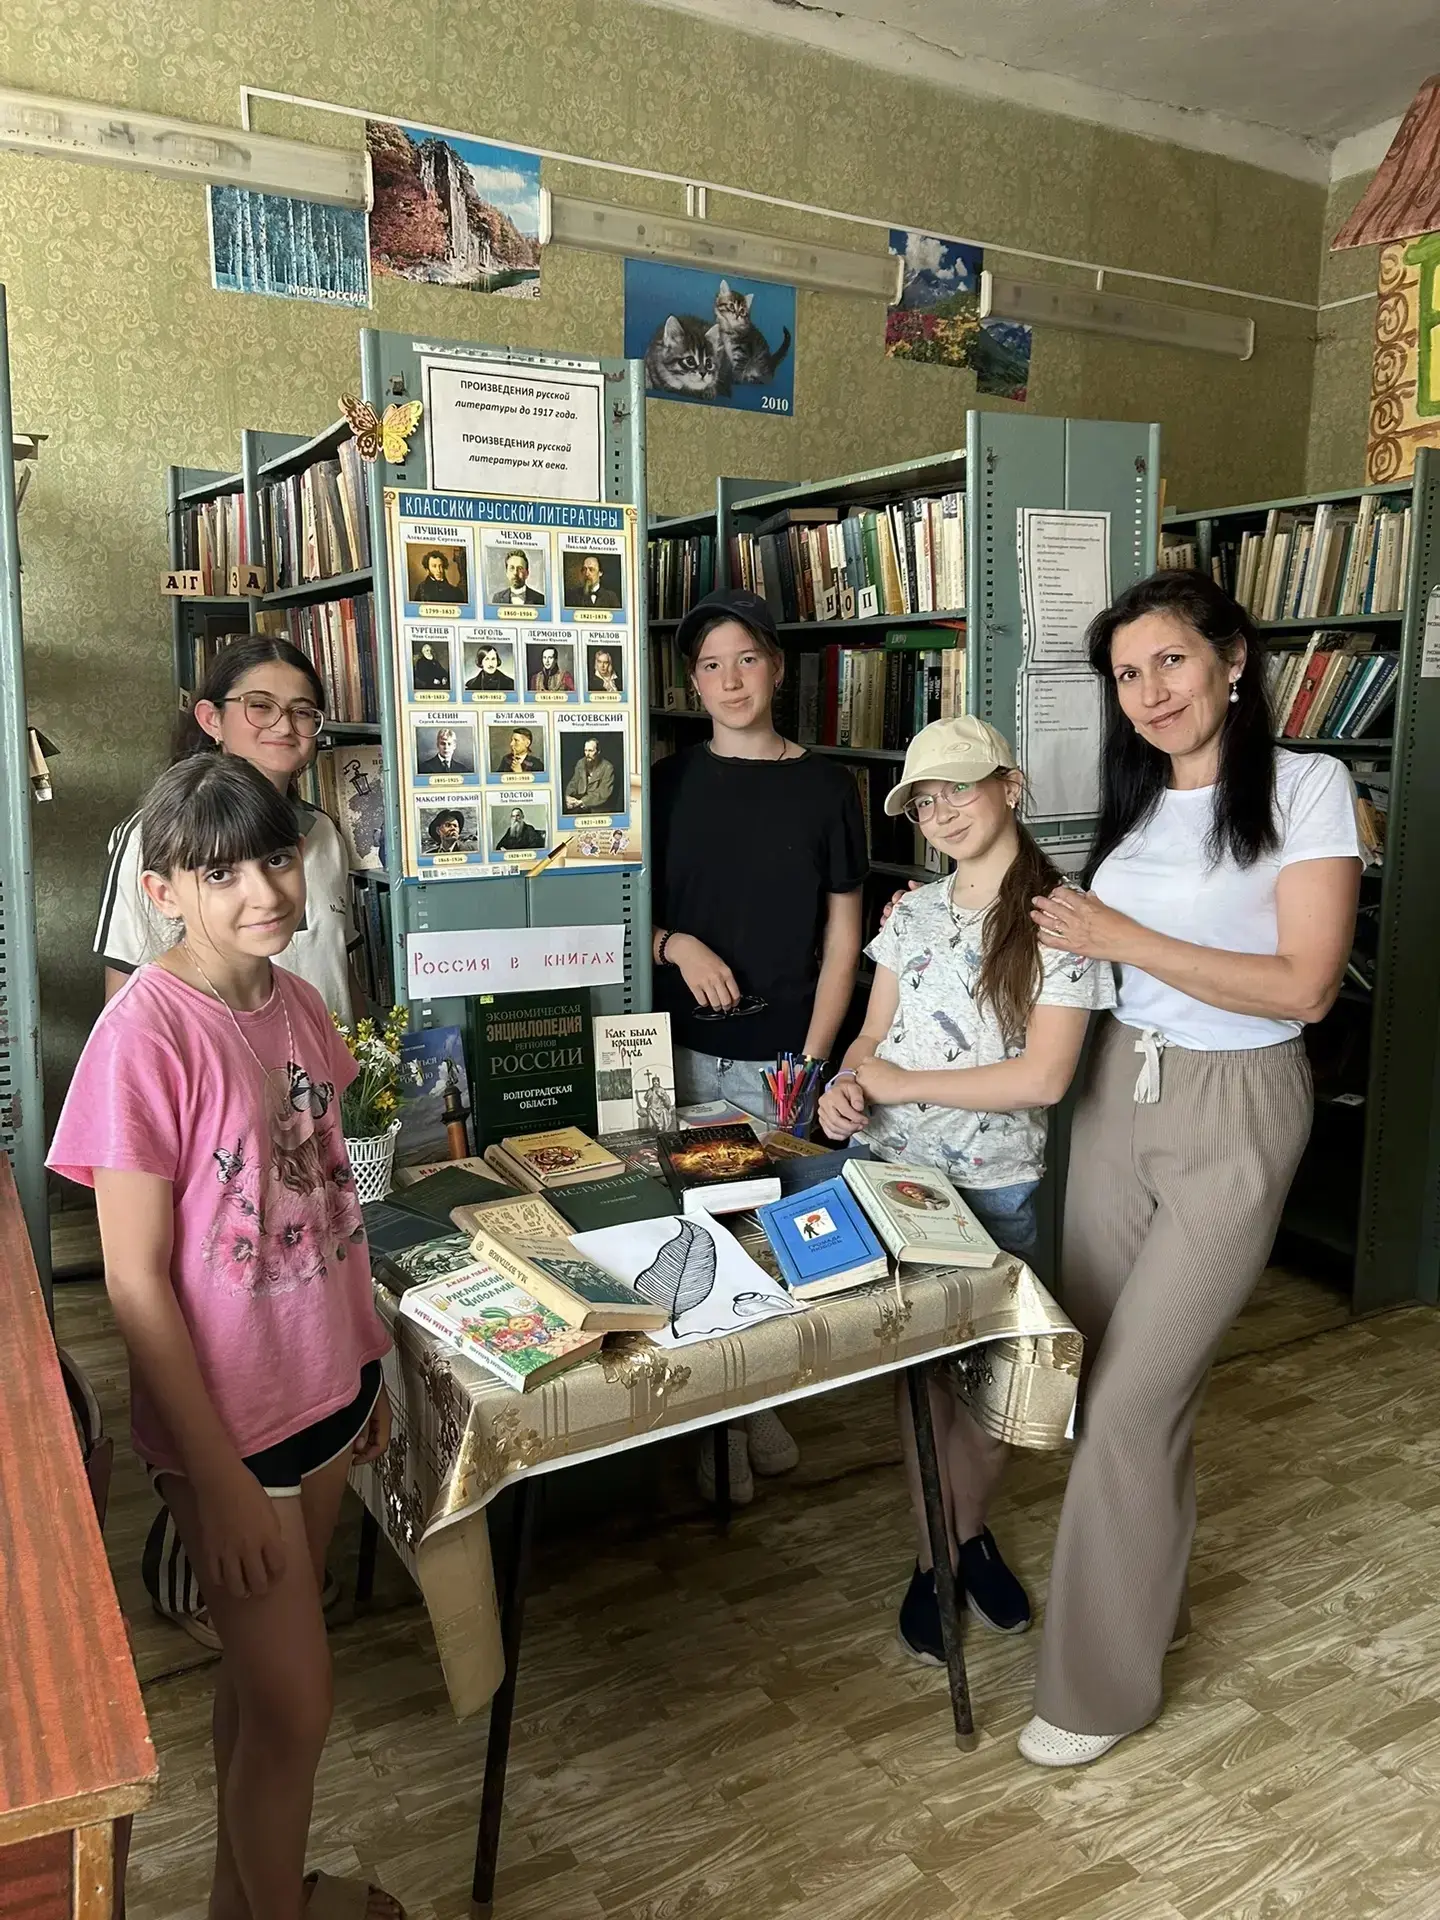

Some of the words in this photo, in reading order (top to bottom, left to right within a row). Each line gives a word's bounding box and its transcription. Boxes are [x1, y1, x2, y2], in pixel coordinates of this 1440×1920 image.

[460, 380, 534, 397] ПРОИЗВЕДЕНИЯ
[536, 389, 570, 401] русской
[455, 400, 518, 415] литературы
[519, 405, 531, 415] до
[532, 406, 553, 418] 1917
[555, 410, 578, 420] года.
[761, 395, 789, 412] 2010
[462, 433, 535, 450] ПРОИЗВЕДЕНИЯ
[537, 442, 572, 453] русской
[468, 454, 530, 468] литературы
[545, 461, 568, 471] века.
[405, 497, 473, 518] КЛАССИКИ
[478, 502, 534, 523] РУССКОЙ
[538, 505, 618, 527] ЛИТЕРАТУРЫ
[414, 525, 458, 537] ПУШКИН
[500, 530, 532, 540] ЧЕХОВ
[567, 535, 616, 546] НЕКРАСОВ
[166, 575, 179, 589] А
[246, 572, 261, 589] А
[826, 596, 834, 613] Н
[845, 595, 852, 612] О
[862, 592, 872, 609] П
[528, 630, 572, 638] ЛЕРМОНТОВ
[558, 713, 623, 722] ДОСТОЕВСКИЙ
[447, 794, 479, 802] ГОРЬКИЙ
[500, 791, 533, 799] ТОЛСТОЙ
[486, 1004, 581, 1021] ЭКОНОМИЧЕСКАЯ
[486, 1016, 582, 1042] ЭНЦИКЛОПЕДИЯ
[515, 1040, 557, 1051] РЕГИОНОВ
[490, 1047, 584, 1075] РОССИИ
[503, 1084, 573, 1101] ВОЛГОГРАДСКАЯ
[520, 1097, 558, 1110] ОБЛАСТЬ
[488, 1249, 518, 1276] БУЛГАКОВ
